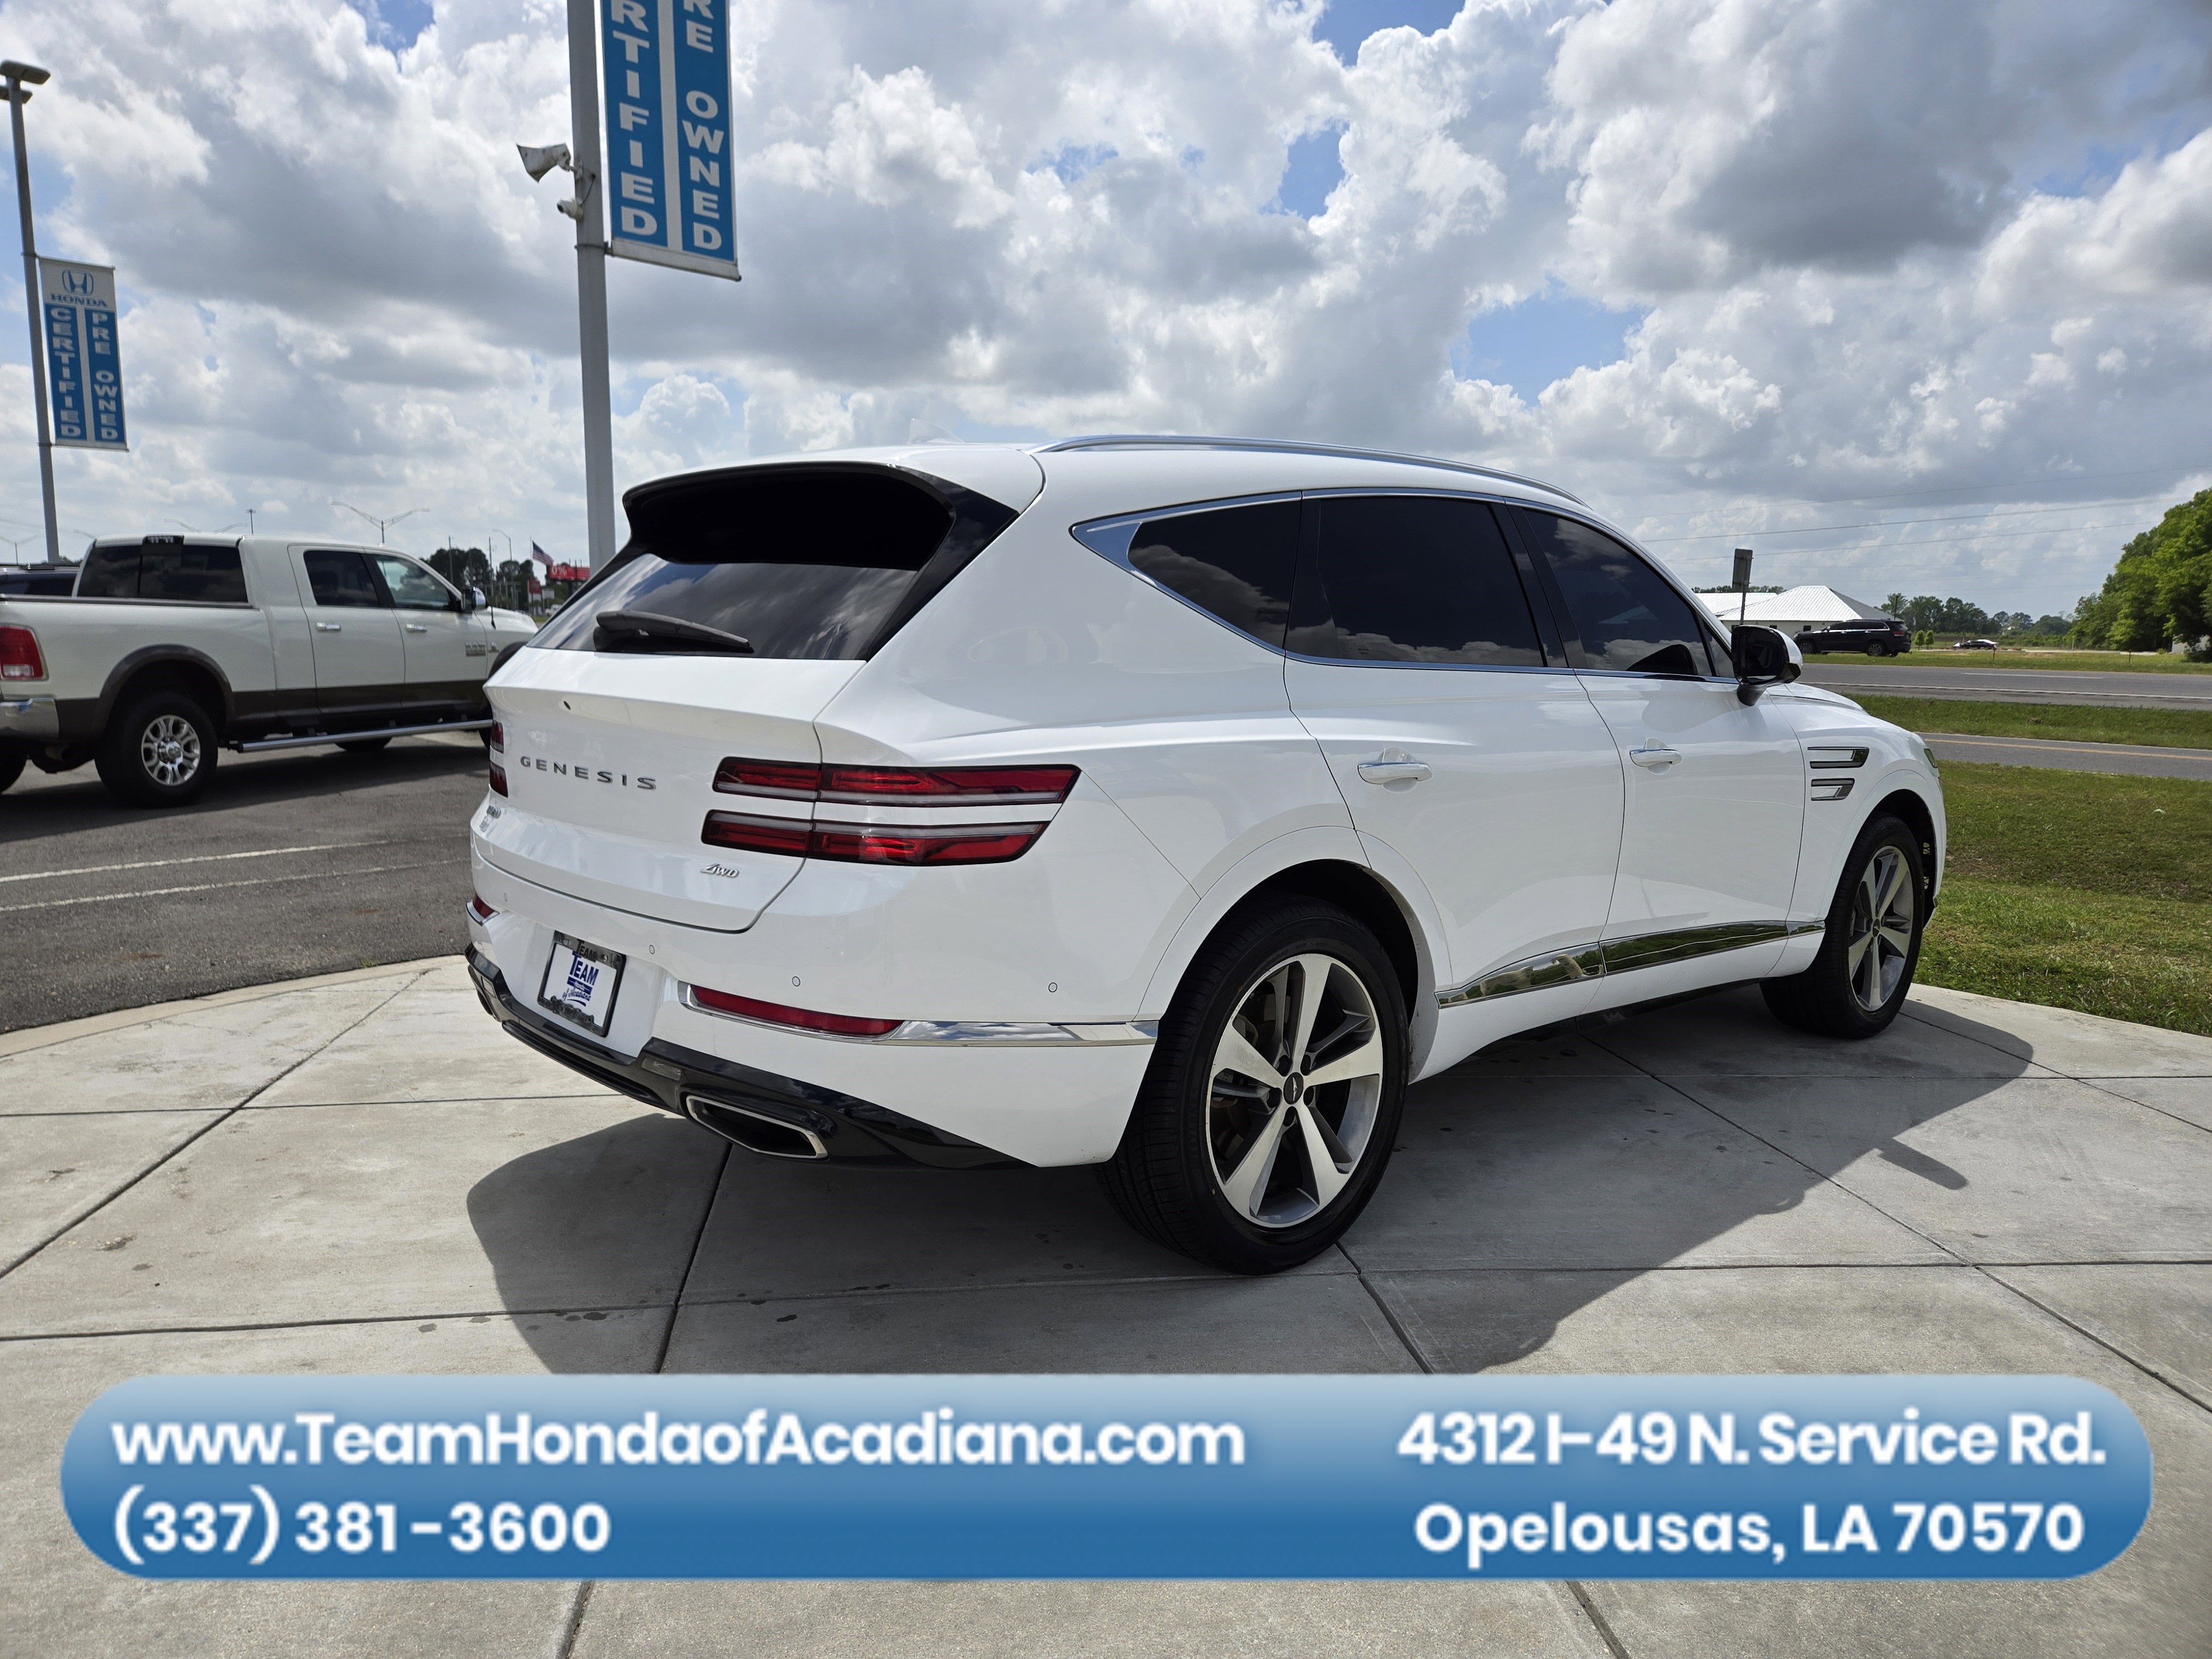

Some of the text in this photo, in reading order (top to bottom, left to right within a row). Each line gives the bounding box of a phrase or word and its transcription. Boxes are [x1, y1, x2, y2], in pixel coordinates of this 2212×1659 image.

[682, 90, 724, 250] OWNED
[50, 293, 108, 307] HONDA
[50, 307, 81, 438] CERTIFIED
[92, 311, 118, 441] PRE OWNED
[520, 755, 657, 790] GENESIS
[569, 950, 599, 986] TEAM
